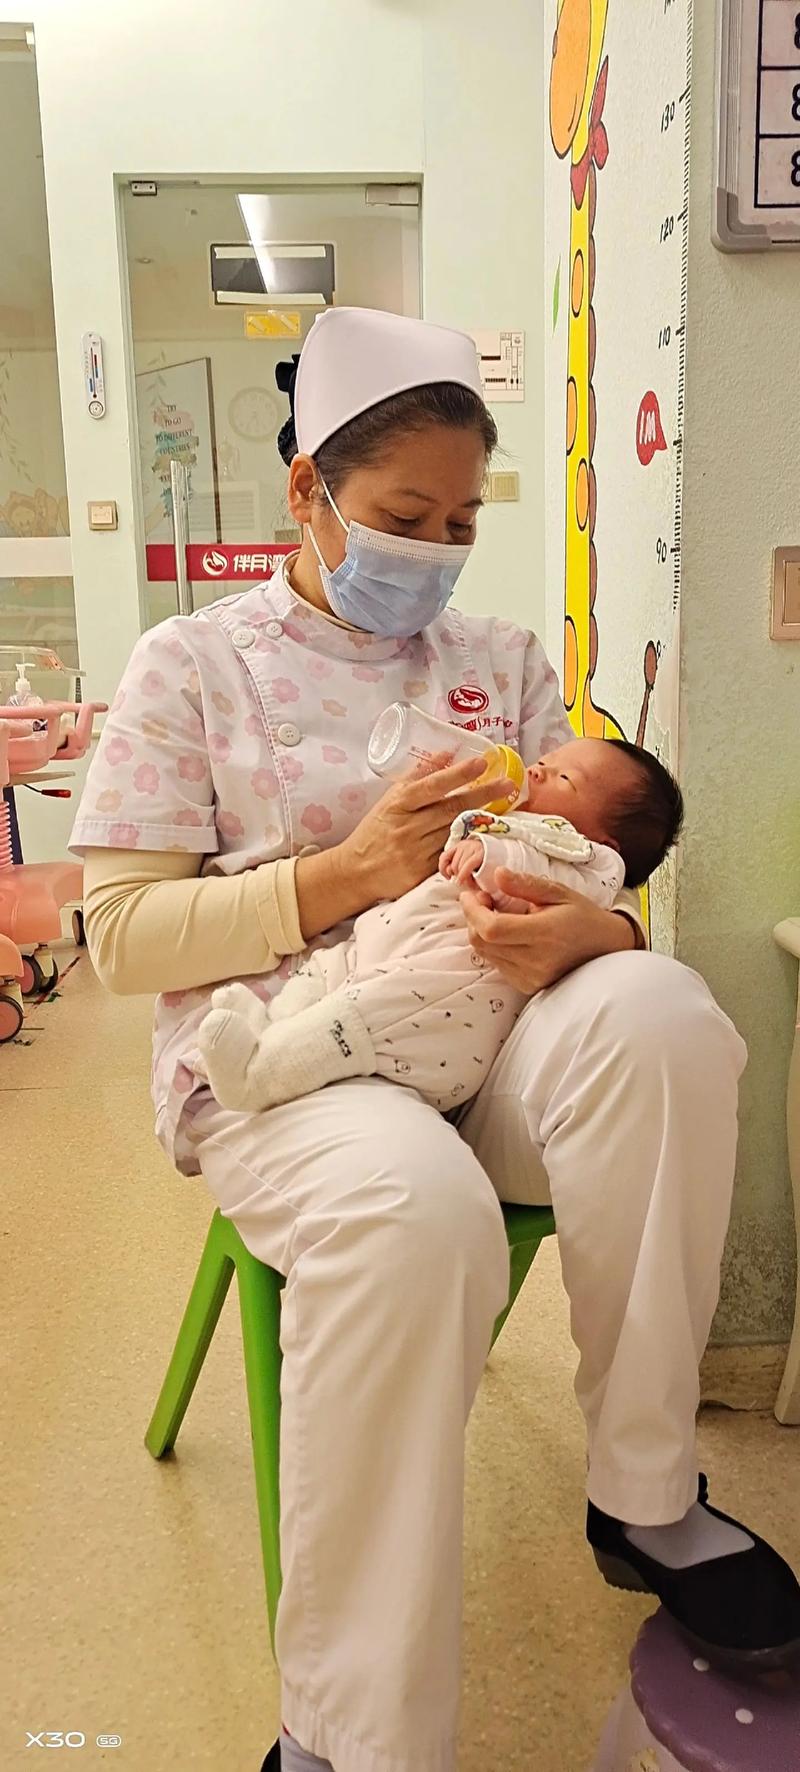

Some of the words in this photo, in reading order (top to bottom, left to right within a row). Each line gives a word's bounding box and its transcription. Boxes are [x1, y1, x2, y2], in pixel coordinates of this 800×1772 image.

[661, 101, 675, 133] 130
[659, 215, 674, 244] 120
[658, 325, 671, 350] 110
[656, 536, 668, 564] 90
